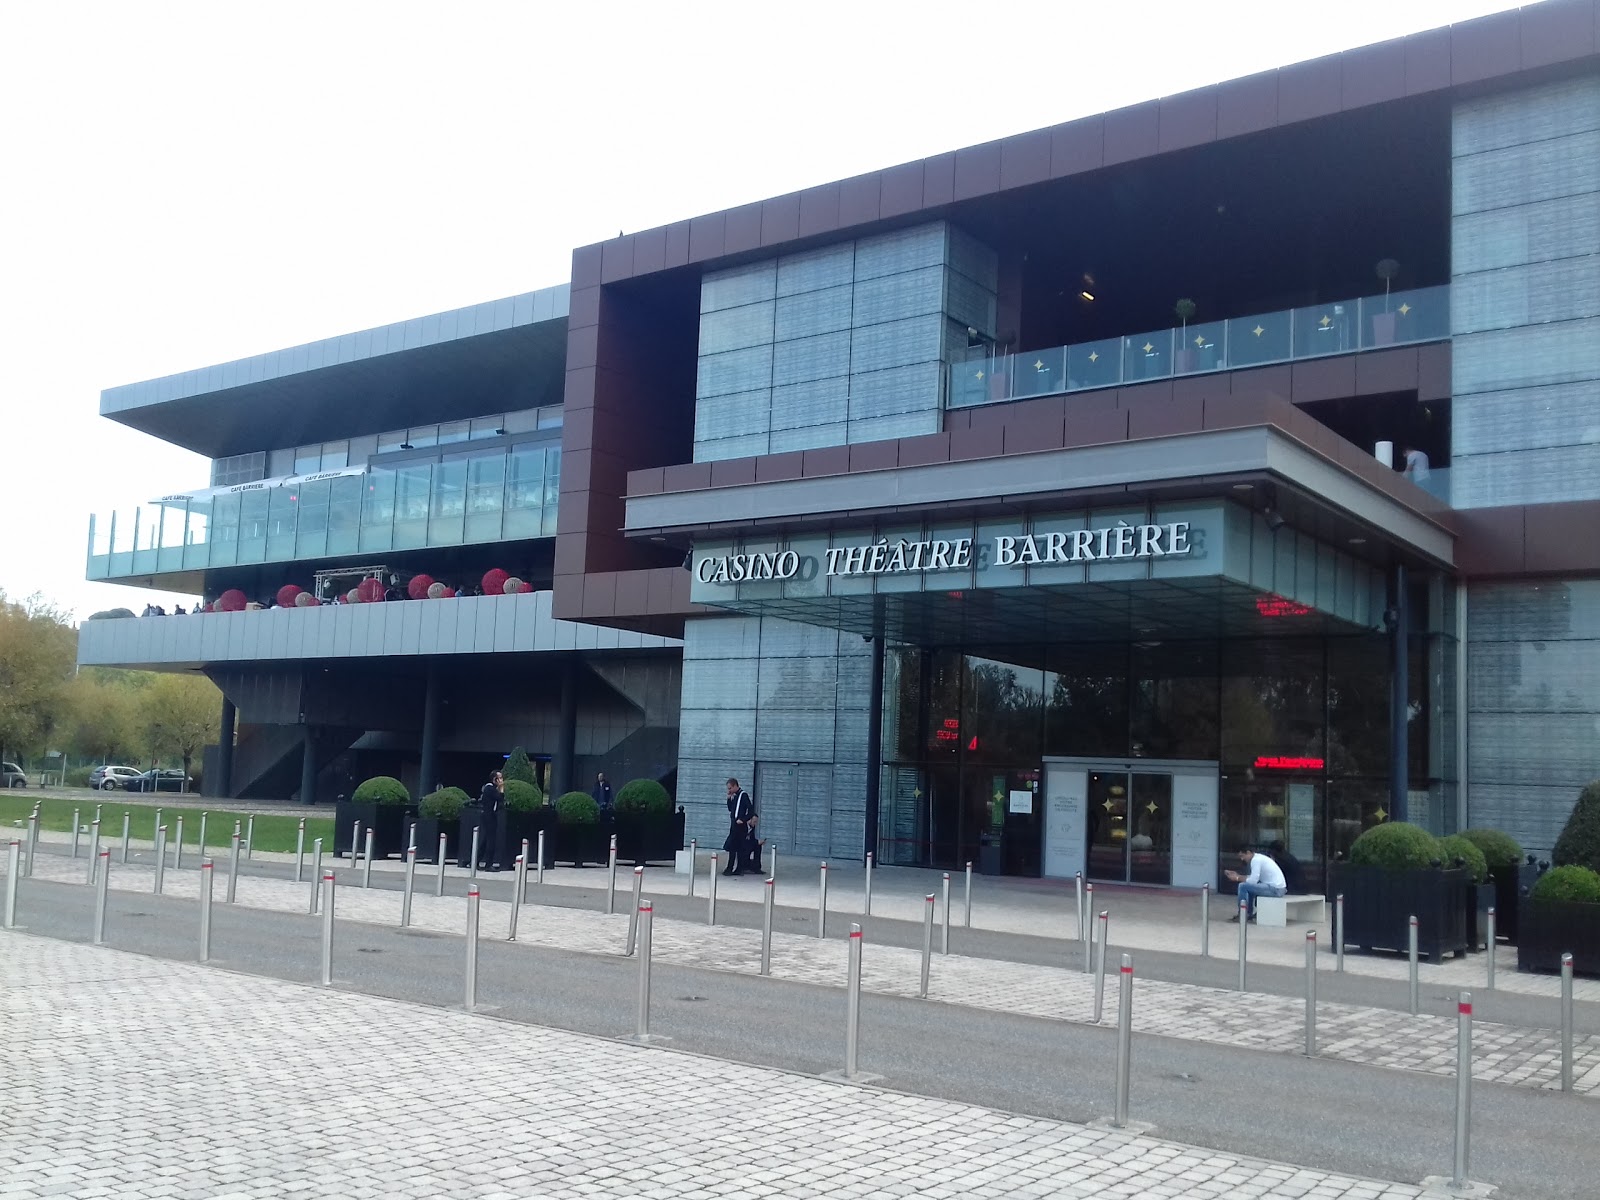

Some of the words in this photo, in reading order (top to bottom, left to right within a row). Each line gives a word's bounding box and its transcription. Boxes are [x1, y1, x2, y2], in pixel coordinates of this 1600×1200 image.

[696, 550, 799, 583] CASINO
[825, 538, 972, 576] THÉÂTRE
[994, 520, 1191, 566] BARRIÈRE
